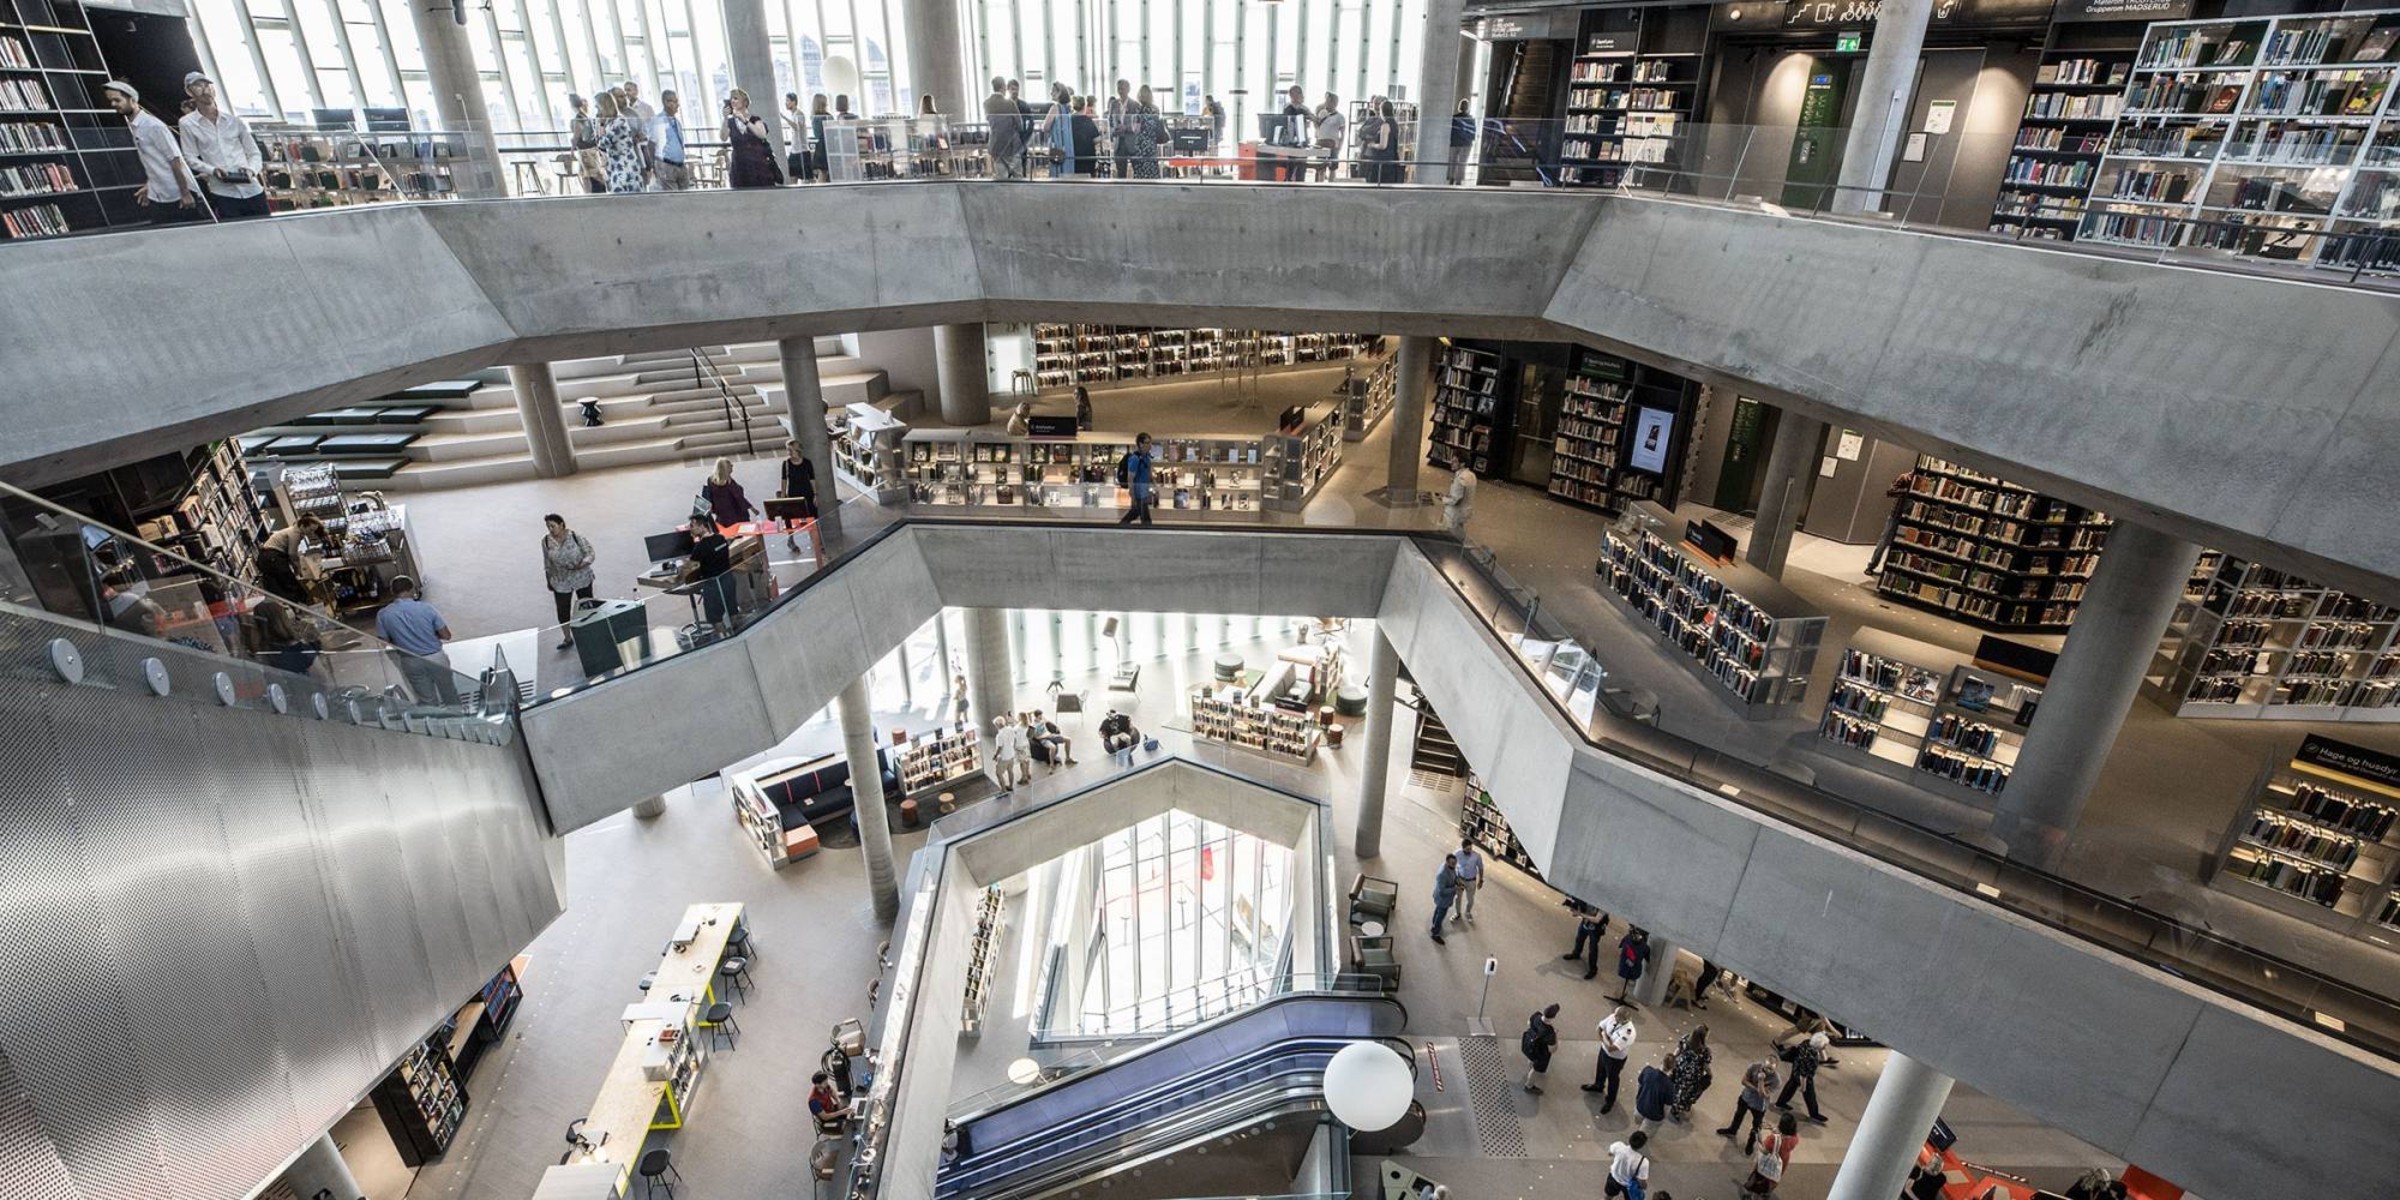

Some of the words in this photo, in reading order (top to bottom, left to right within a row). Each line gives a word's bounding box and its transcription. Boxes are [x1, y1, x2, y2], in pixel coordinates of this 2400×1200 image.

[2125, 3, 2170, 11] MADSERUD
[2320, 747, 2345, 760] Hage
[2346, 756, 2360, 765] og
[2362, 759, 2399, 775] husdyr
